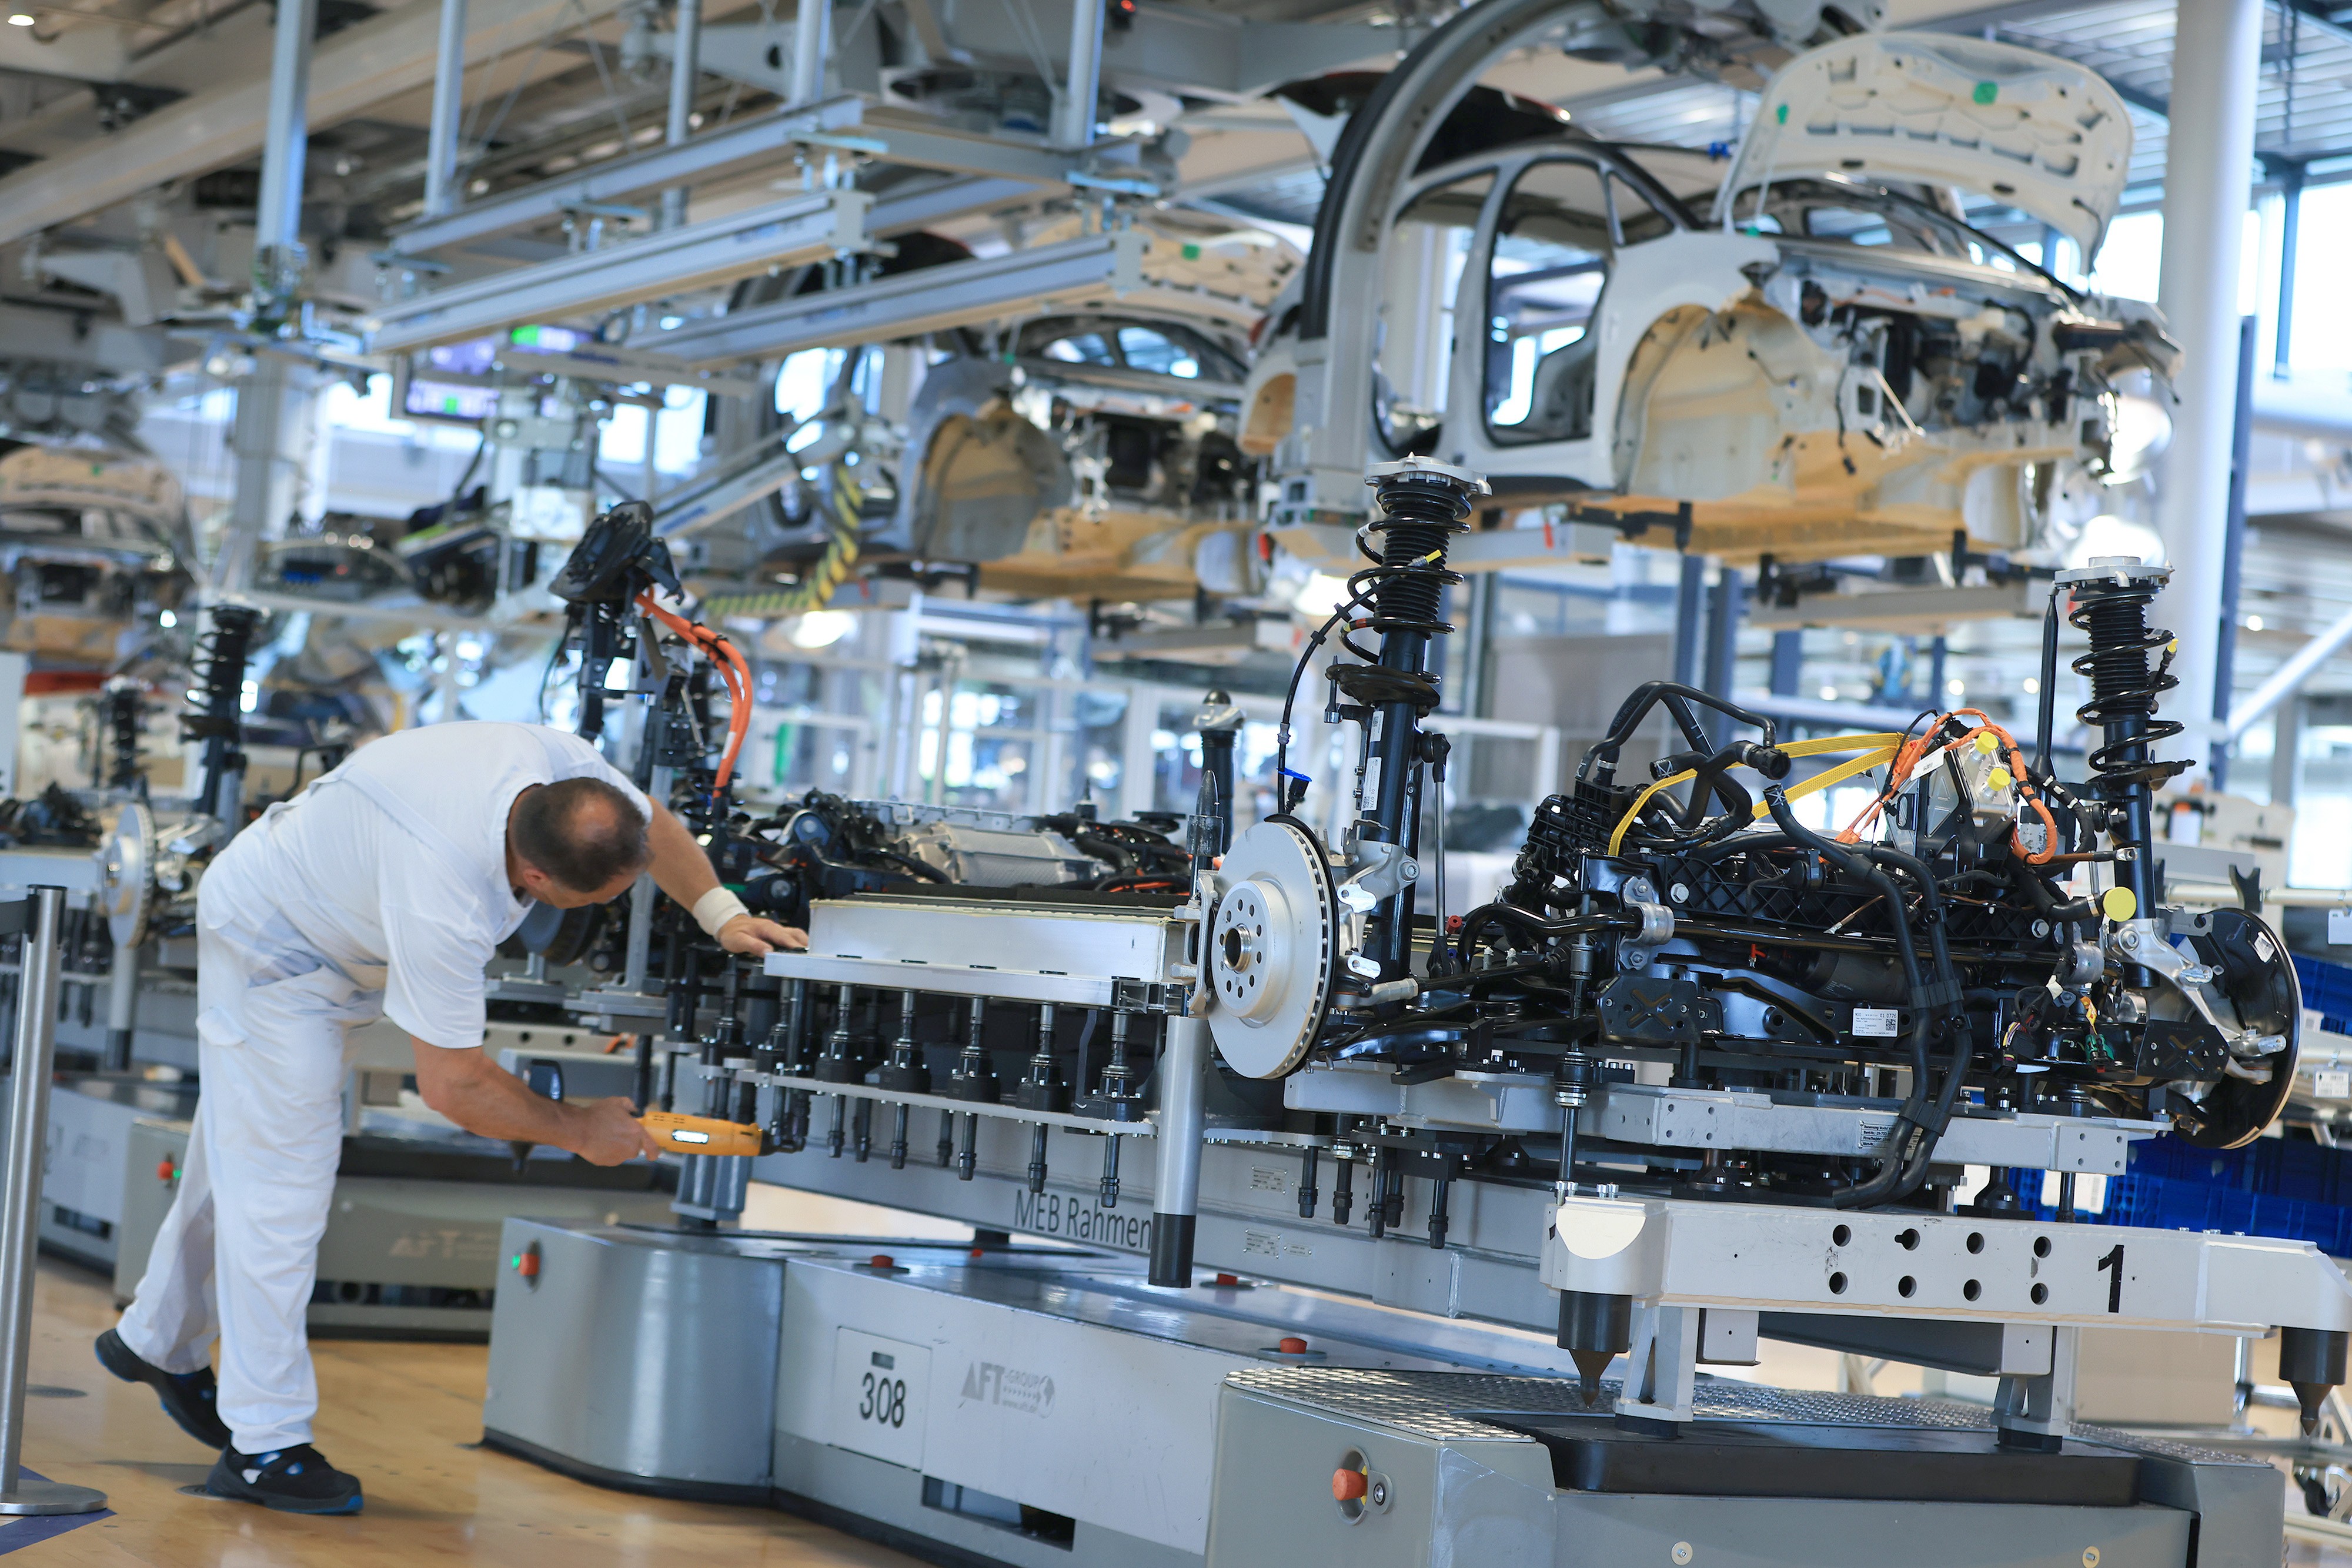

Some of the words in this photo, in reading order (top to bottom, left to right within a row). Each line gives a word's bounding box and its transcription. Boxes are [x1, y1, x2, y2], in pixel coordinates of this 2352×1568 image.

[1014, 1189, 1060, 1233] MEB
[1066, 1197, 1152, 1251] Rahmen
[2098, 1244, 2124, 1313] 1
[860, 1372, 906, 1429] 308
[961, 1361, 1005, 1405] AFT
